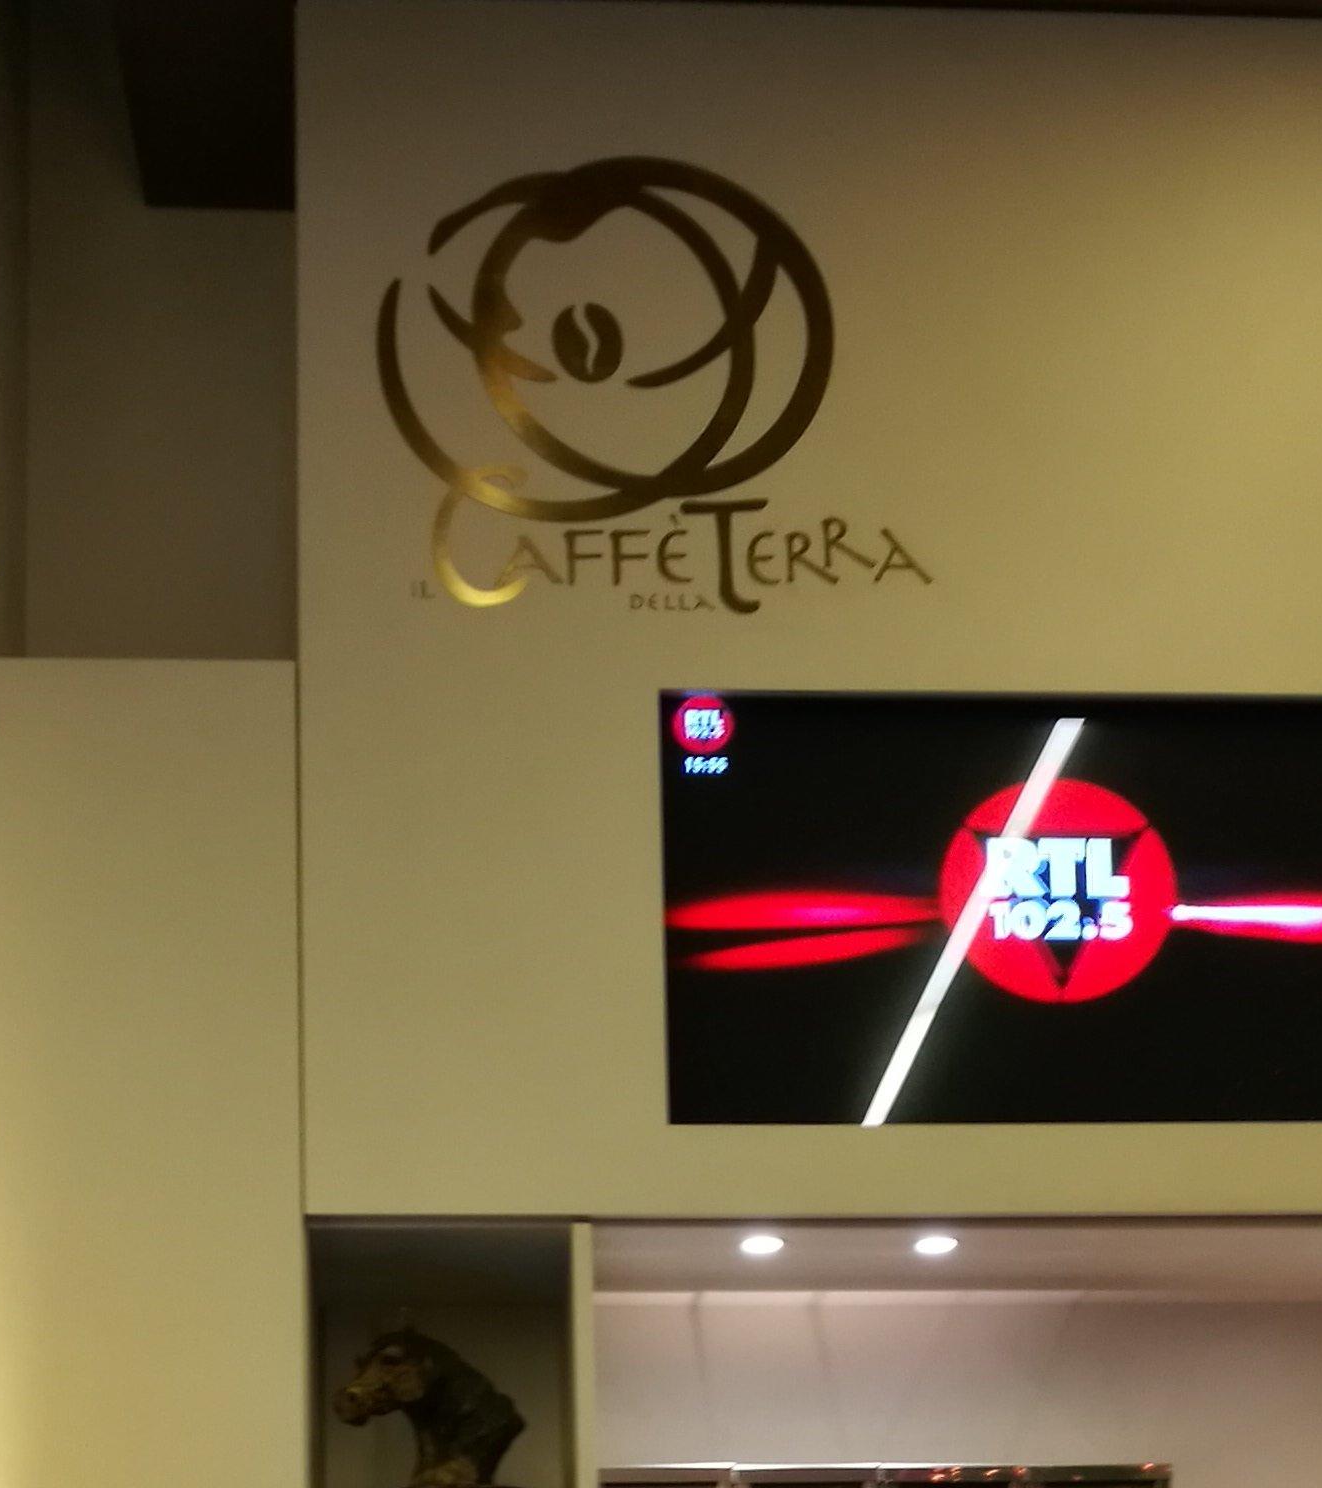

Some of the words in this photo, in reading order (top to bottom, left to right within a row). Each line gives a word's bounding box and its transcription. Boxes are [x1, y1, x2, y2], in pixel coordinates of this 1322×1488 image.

[680, 498, 933, 615] TERRA
[630, 592, 716, 611] DELLA
[986, 836, 1131, 900] RTL
[988, 900, 1134, 941] 102.5
